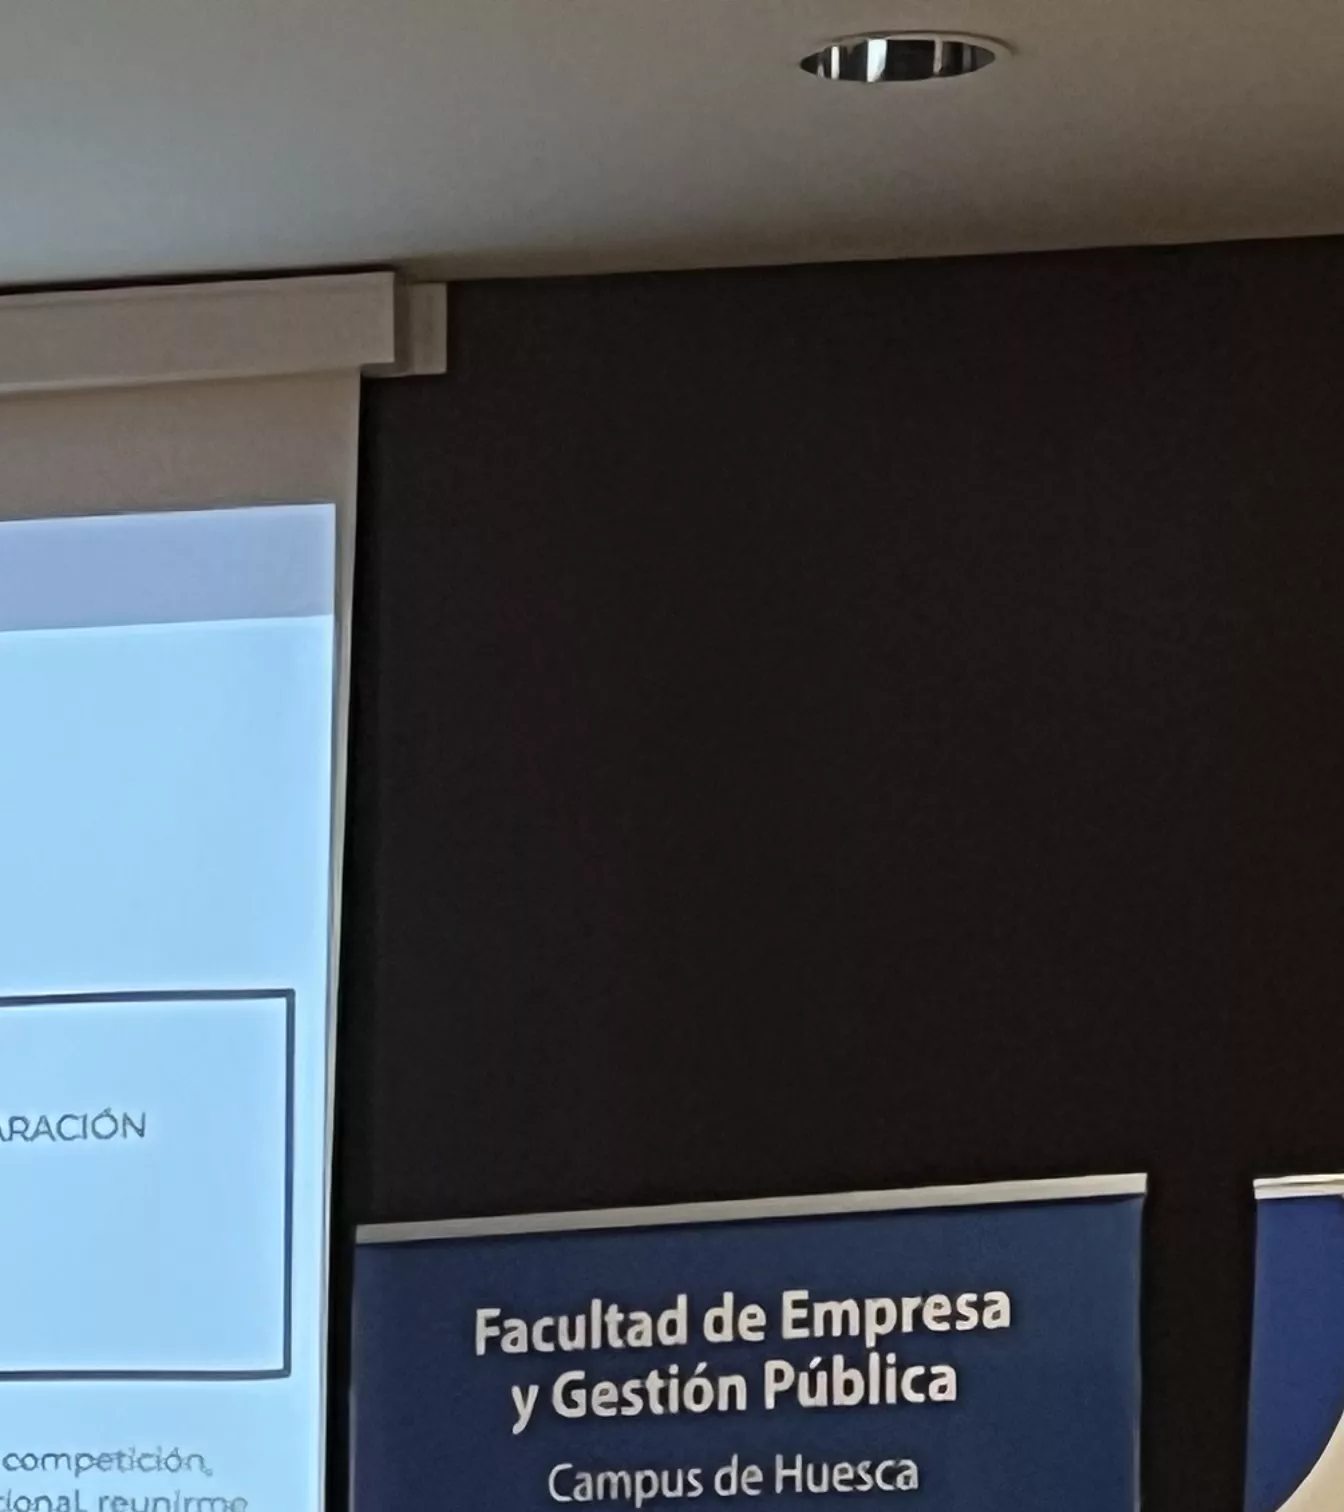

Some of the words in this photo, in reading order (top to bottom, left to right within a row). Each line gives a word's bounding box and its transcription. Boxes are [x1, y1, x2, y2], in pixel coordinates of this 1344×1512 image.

[475, 1293, 688, 1356] Facultad
[703, 1291, 767, 1343] de
[781, 1289, 1011, 1349] Empresa
[511, 1384, 540, 1435] y
[551, 1361, 747, 1418] Gestión
[764, 1351, 957, 1410] Pública
[0, 1445, 214, 1479] competición,
[548, 1462, 704, 1509] Campus
[714, 1453, 764, 1497] de
[775, 1453, 919, 1494] Huesca
